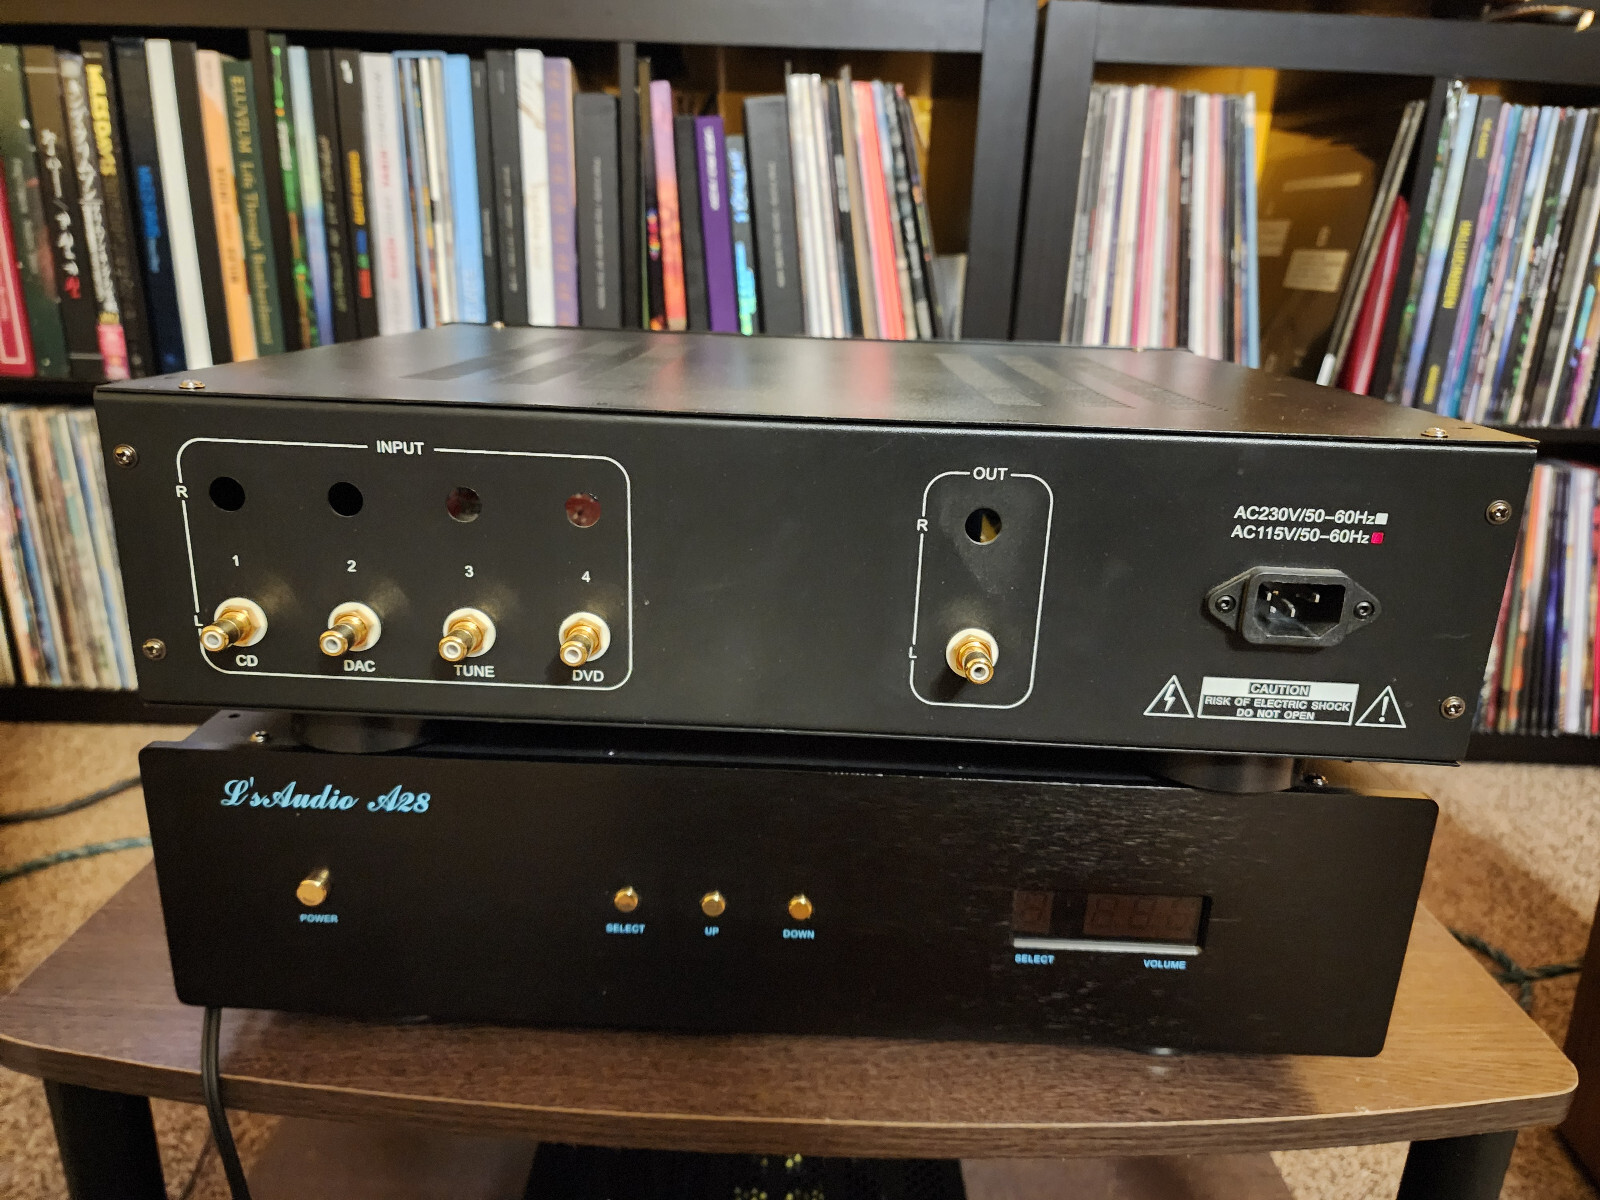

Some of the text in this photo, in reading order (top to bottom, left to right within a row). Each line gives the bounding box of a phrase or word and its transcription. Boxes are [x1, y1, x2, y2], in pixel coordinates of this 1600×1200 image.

[376, 440, 425, 456] INPUT
[972, 467, 1009, 481] OUT
[175, 485, 188, 499] R
[916, 518, 929, 532] R
[231, 554, 240, 567] 1
[346, 559, 357, 573] 2
[464, 565, 475, 578] 3
[580, 570, 591, 583] 4
[908, 645, 918, 659] L
[235, 654, 259, 668] CD
[343, 659, 377, 673] DAC
[453, 664, 496, 679] TUNE
[572, 668, 605, 683] DVD
[1250, 683, 1310, 696] CAUTION
[1204, 696, 1351, 712] RISK OF ELECTRIC SHOCK
[1236, 708, 1316, 721] DO NOT OPEN
[366, 784, 432, 813] A28
[299, 913, 339, 924] POWER
[605, 922, 646, 935] SELECT
[704, 926, 720, 937] UP
[782, 928, 815, 940] DOWN
[1014, 953, 1055, 965] SELECT
[1143, 958, 1187, 970] VOLUME
